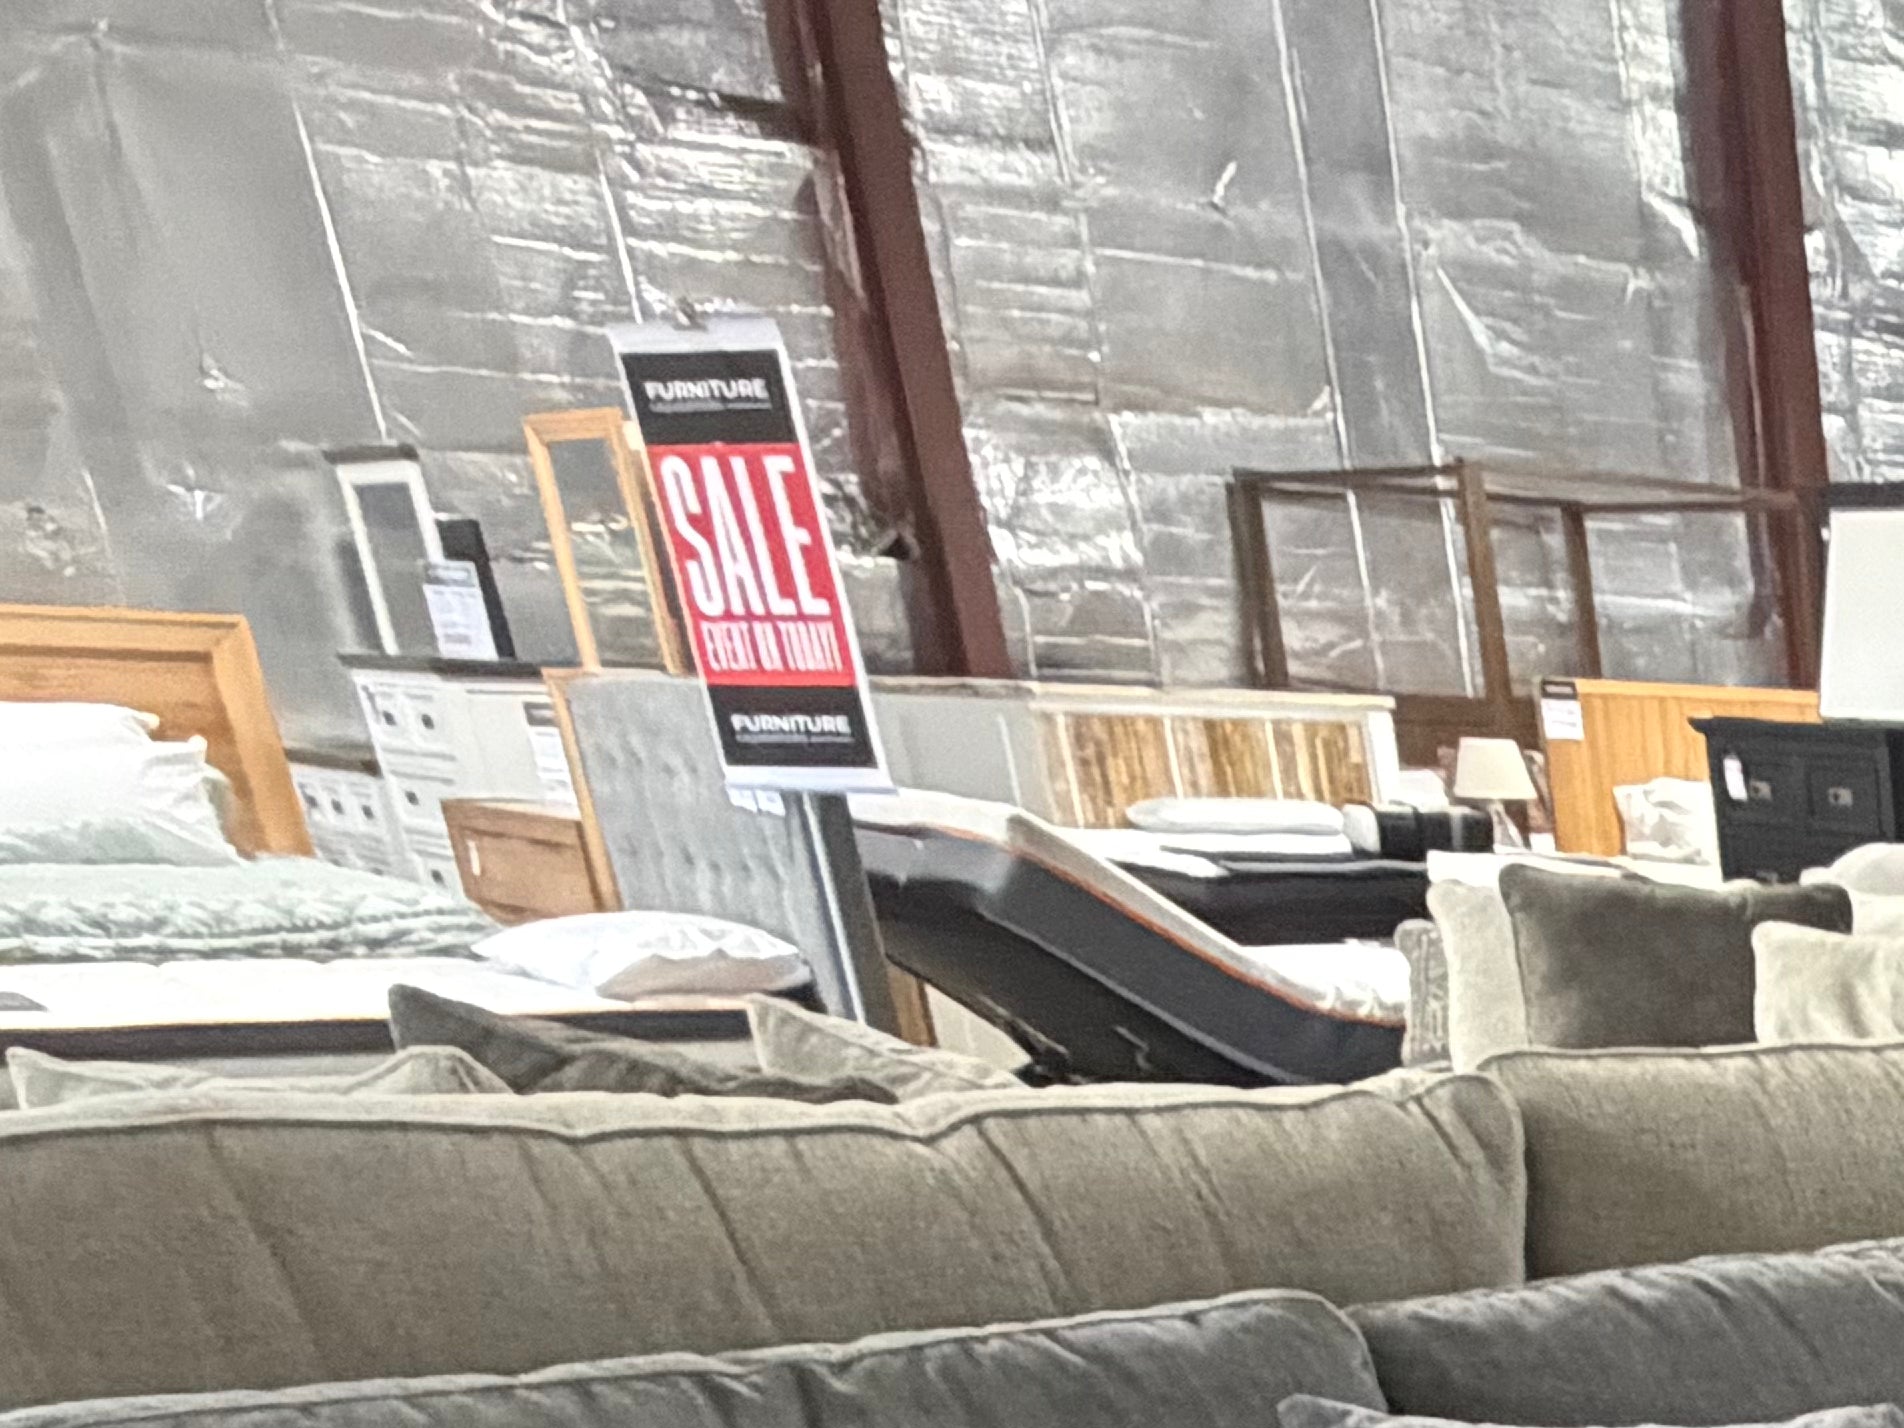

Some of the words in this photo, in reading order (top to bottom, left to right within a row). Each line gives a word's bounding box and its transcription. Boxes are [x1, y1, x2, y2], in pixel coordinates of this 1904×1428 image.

[643, 377, 770, 401] FURNITURE
[660, 454, 831, 616] SALE
[730, 713, 851, 734] FURNITURE
